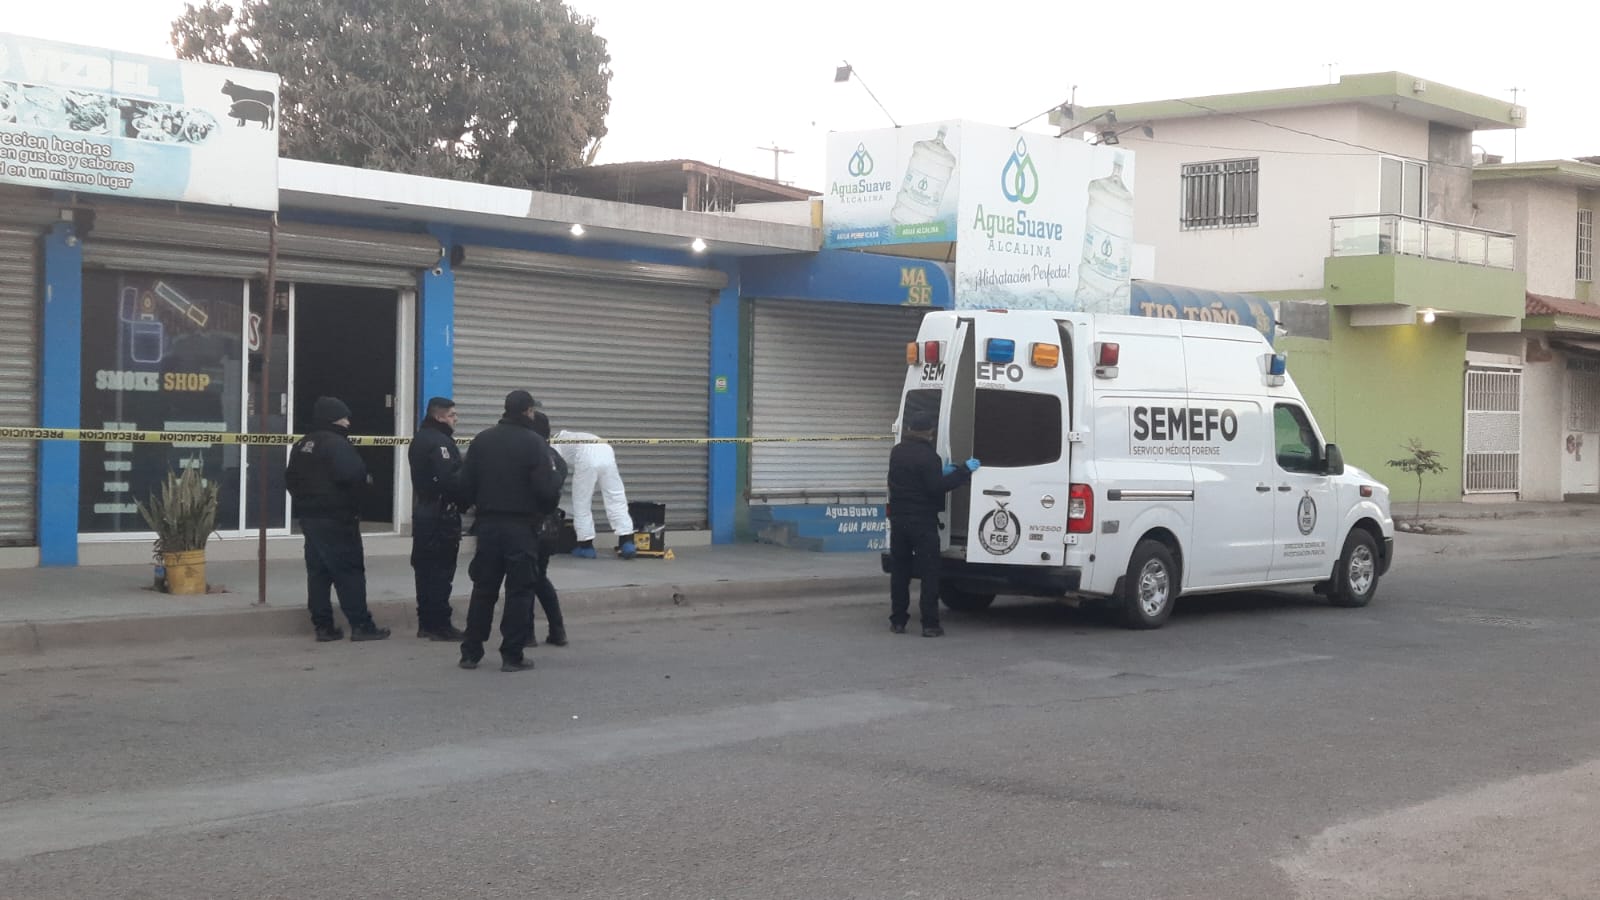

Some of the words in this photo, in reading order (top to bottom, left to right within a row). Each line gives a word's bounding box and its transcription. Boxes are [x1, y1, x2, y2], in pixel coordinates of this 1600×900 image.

[52, 135, 112, 157] hechas
[19, 149, 67, 166] gustos
[68, 155, 79, 169] y
[79, 156, 135, 173] sabores
[7, 164, 27, 177] en
[29, 167, 48, 180] un
[49, 169, 95, 184] mismo
[97, 173, 134, 190] lugar
[830, 178, 892, 198] AguaSuave
[841, 194, 884, 204] ALCALINA
[973, 203, 1063, 241] AguaSuave
[987, 239, 1052, 258] ALCALINA
[900, 267, 927, 287] MA
[96, 370, 159, 392] SMOKE
[163, 372, 211, 391] SHOP
[976, 361, 1024, 383] EFO
[1133, 406, 1238, 442] SEMEFO
[0, 428, 64, 439] PRECAUCIO
[79, 430, 147, 441] PRECAUCION
[159, 432, 223, 442] PRECAUCION
[235, 434, 296, 444] PRECAUCION
[1133, 446, 1164, 456] SERVICIO
[1191, 446, 1221, 456] FORENSE
[825, 505, 878, 519] AguaSuave
[838, 522, 858, 534] AGUA
[860, 521, 886, 532] PURIF
[990, 533, 1009, 543] FGE
